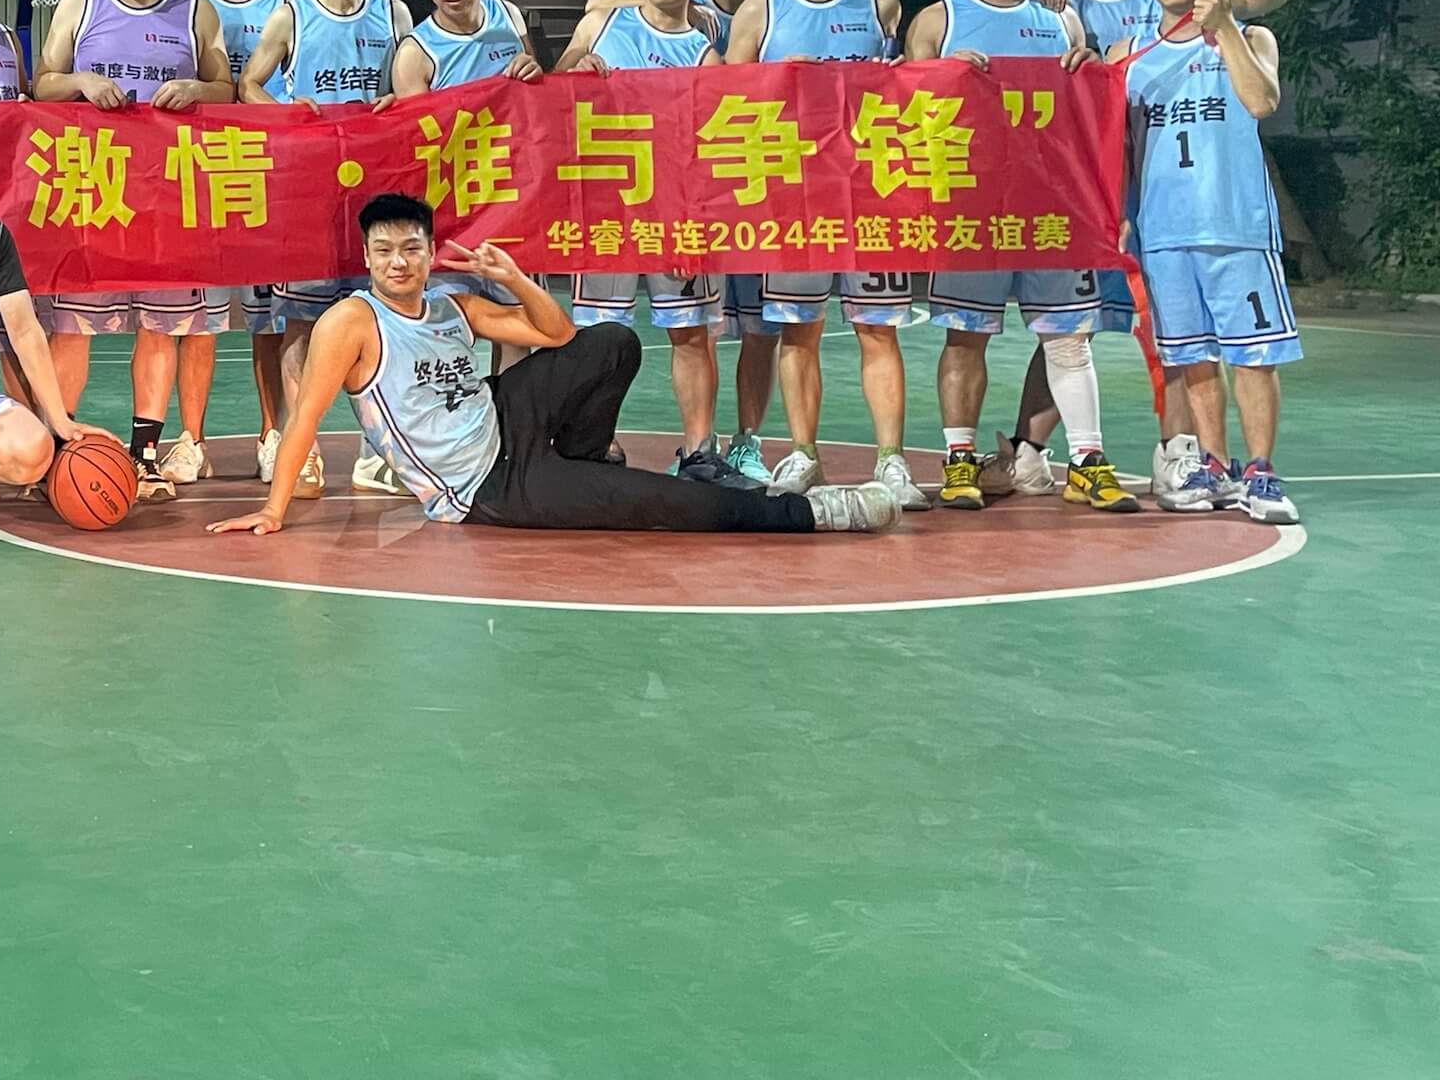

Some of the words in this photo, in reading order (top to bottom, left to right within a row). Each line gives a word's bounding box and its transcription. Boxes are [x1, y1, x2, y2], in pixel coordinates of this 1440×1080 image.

[90, 62, 178, 81] 速度与激情
[314, 66, 382, 94] 终结者
[1143, 96, 1227, 128] 终结者
[1176, 131, 1194, 168] 1
[1246, 291, 1271, 330] 1
